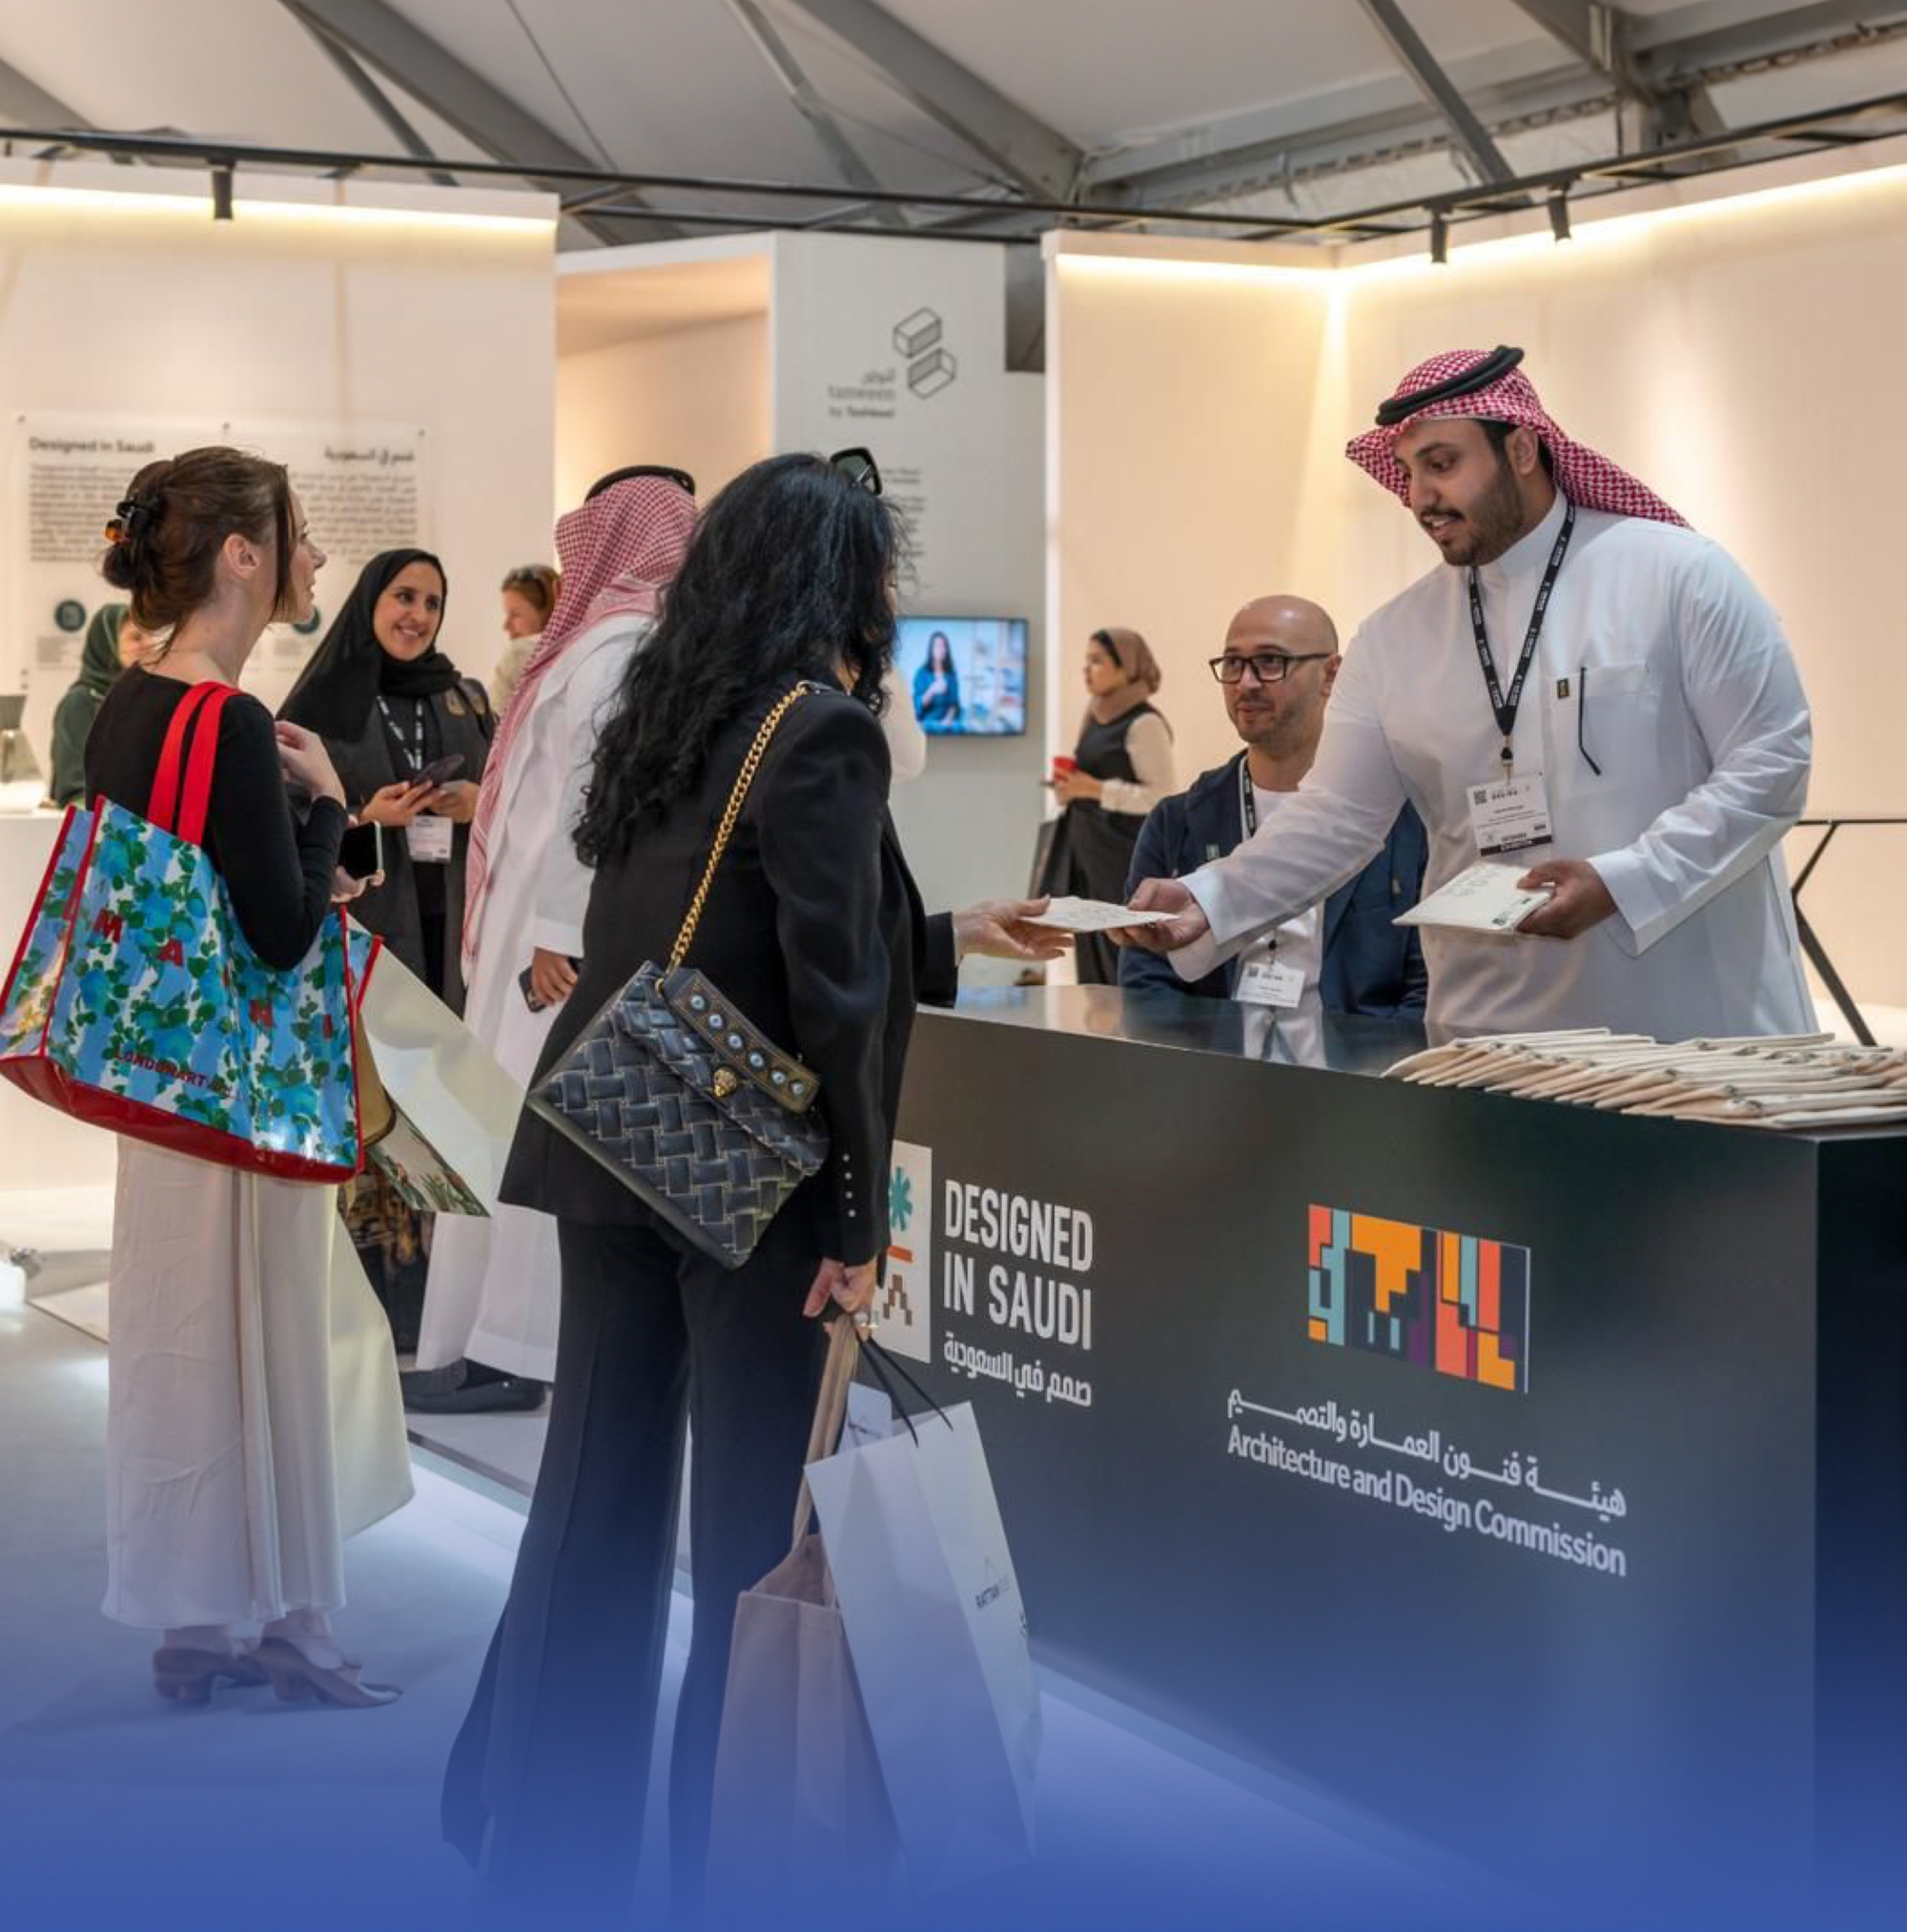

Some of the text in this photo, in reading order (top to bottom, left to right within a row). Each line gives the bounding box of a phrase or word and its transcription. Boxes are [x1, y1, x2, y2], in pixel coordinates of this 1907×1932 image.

[30, 437, 96, 454] Designed
[116, 441, 154, 453] Saudi
[945, 1179, 1094, 1272] DESIGNED
[944, 1251, 1091, 1350] IN SAUDI
[943, 1331, 1092, 1407] صمم في السعودية
[1227, 1388, 1627, 1522] هيئة فنون العمارة والتصميم
[1227, 1425, 1627, 1576] Architecture and Design Commission
